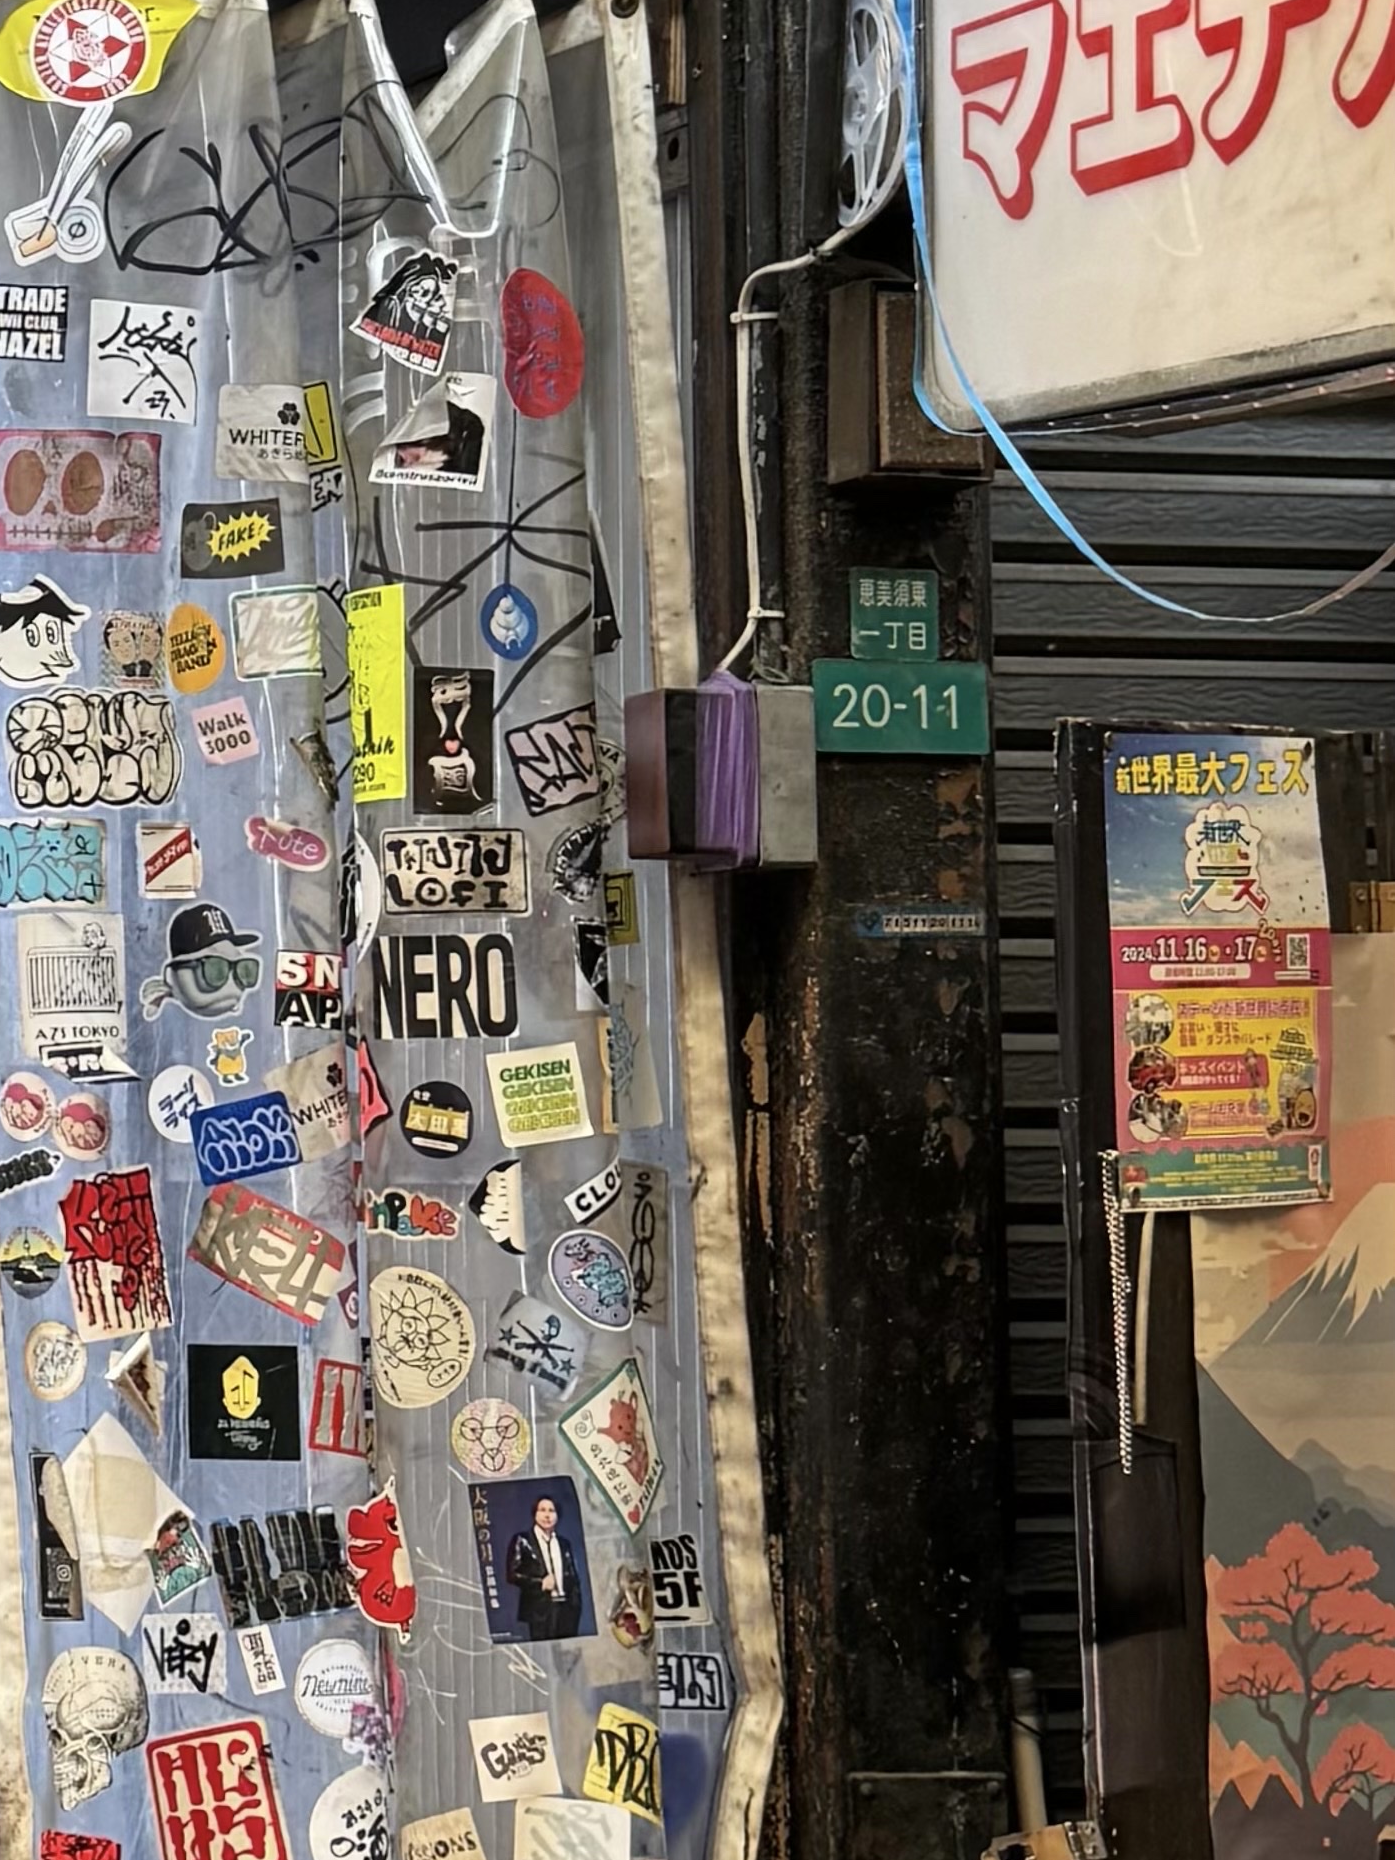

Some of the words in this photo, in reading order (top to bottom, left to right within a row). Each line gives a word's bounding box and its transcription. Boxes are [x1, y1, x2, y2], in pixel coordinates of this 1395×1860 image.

[218, 521, 263, 551] FAKE!
[859, 578, 928, 608] 恵美須東
[860, 621, 928, 650] 一丁目
[832, 683, 960, 729] 20-11
[197, 712, 247, 737] Walk
[1114, 747, 1309, 797] 新世界最大フェス
[373, 933, 520, 1039] NERO
[72, 1025, 120, 1040] TOKYO
[500, 1059, 571, 1082] GEKISEN
[502, 1075, 574, 1100] GEKISEN
